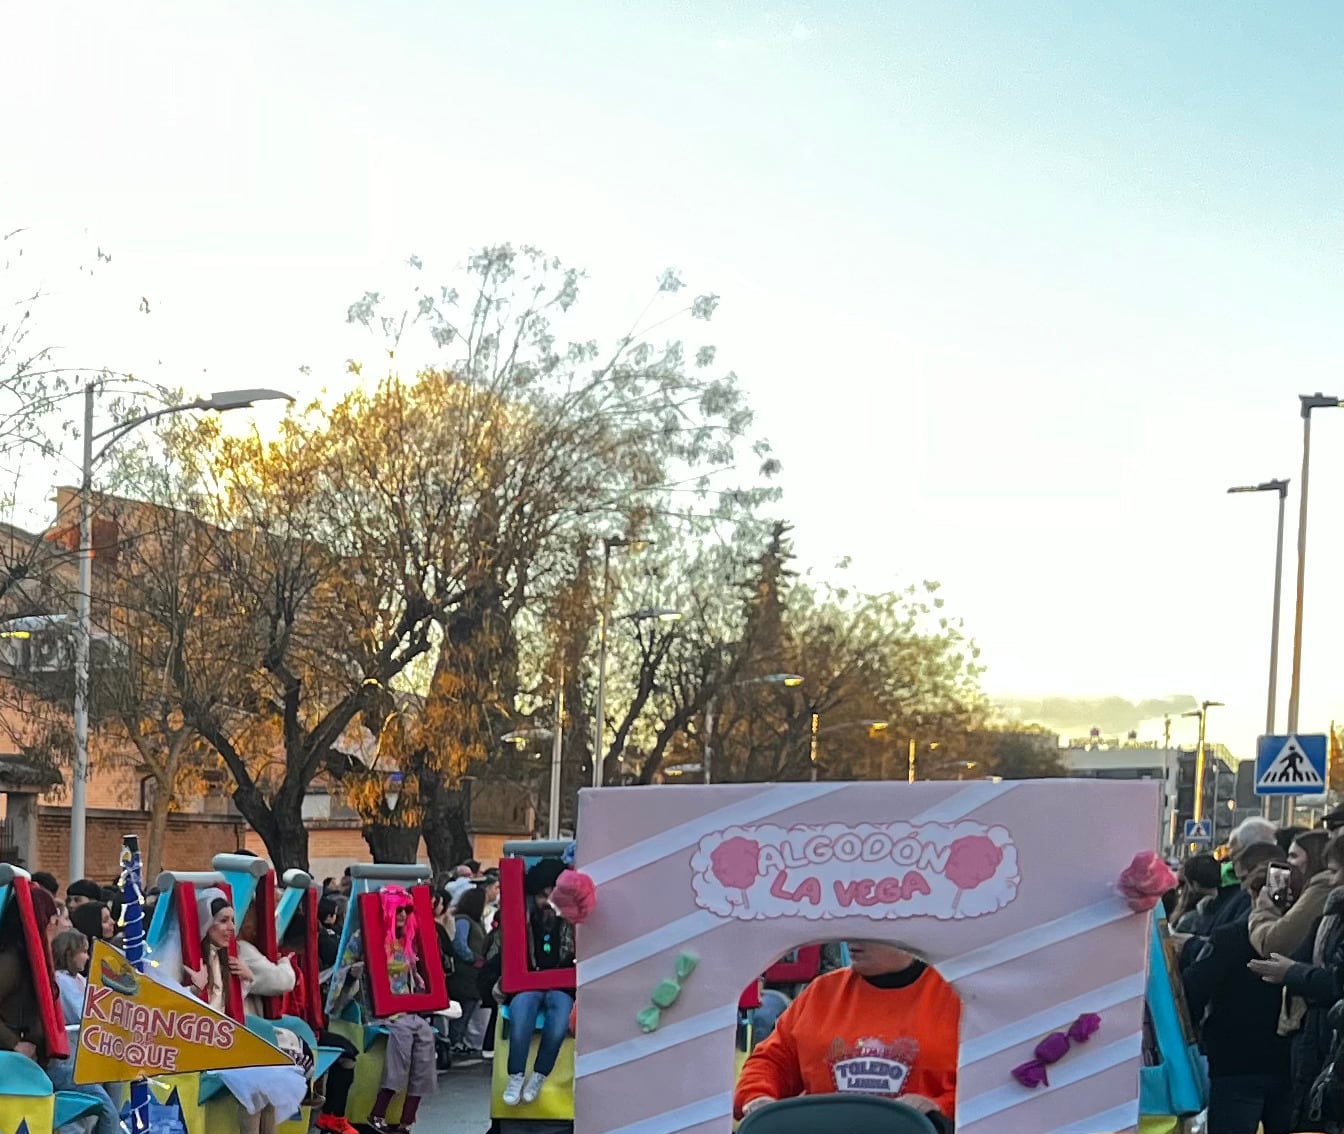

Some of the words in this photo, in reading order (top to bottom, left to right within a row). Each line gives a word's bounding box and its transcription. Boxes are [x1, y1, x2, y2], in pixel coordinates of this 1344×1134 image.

[758, 831, 953, 876] ALGODÓN
[770, 870, 822, 905] LA
[833, 871, 931, 907] VEGA
[85, 985, 236, 1049] KATANGAS
[82, 1025, 179, 1072] CHOQUE
[835, 1060, 904, 1080] TOLEDO
